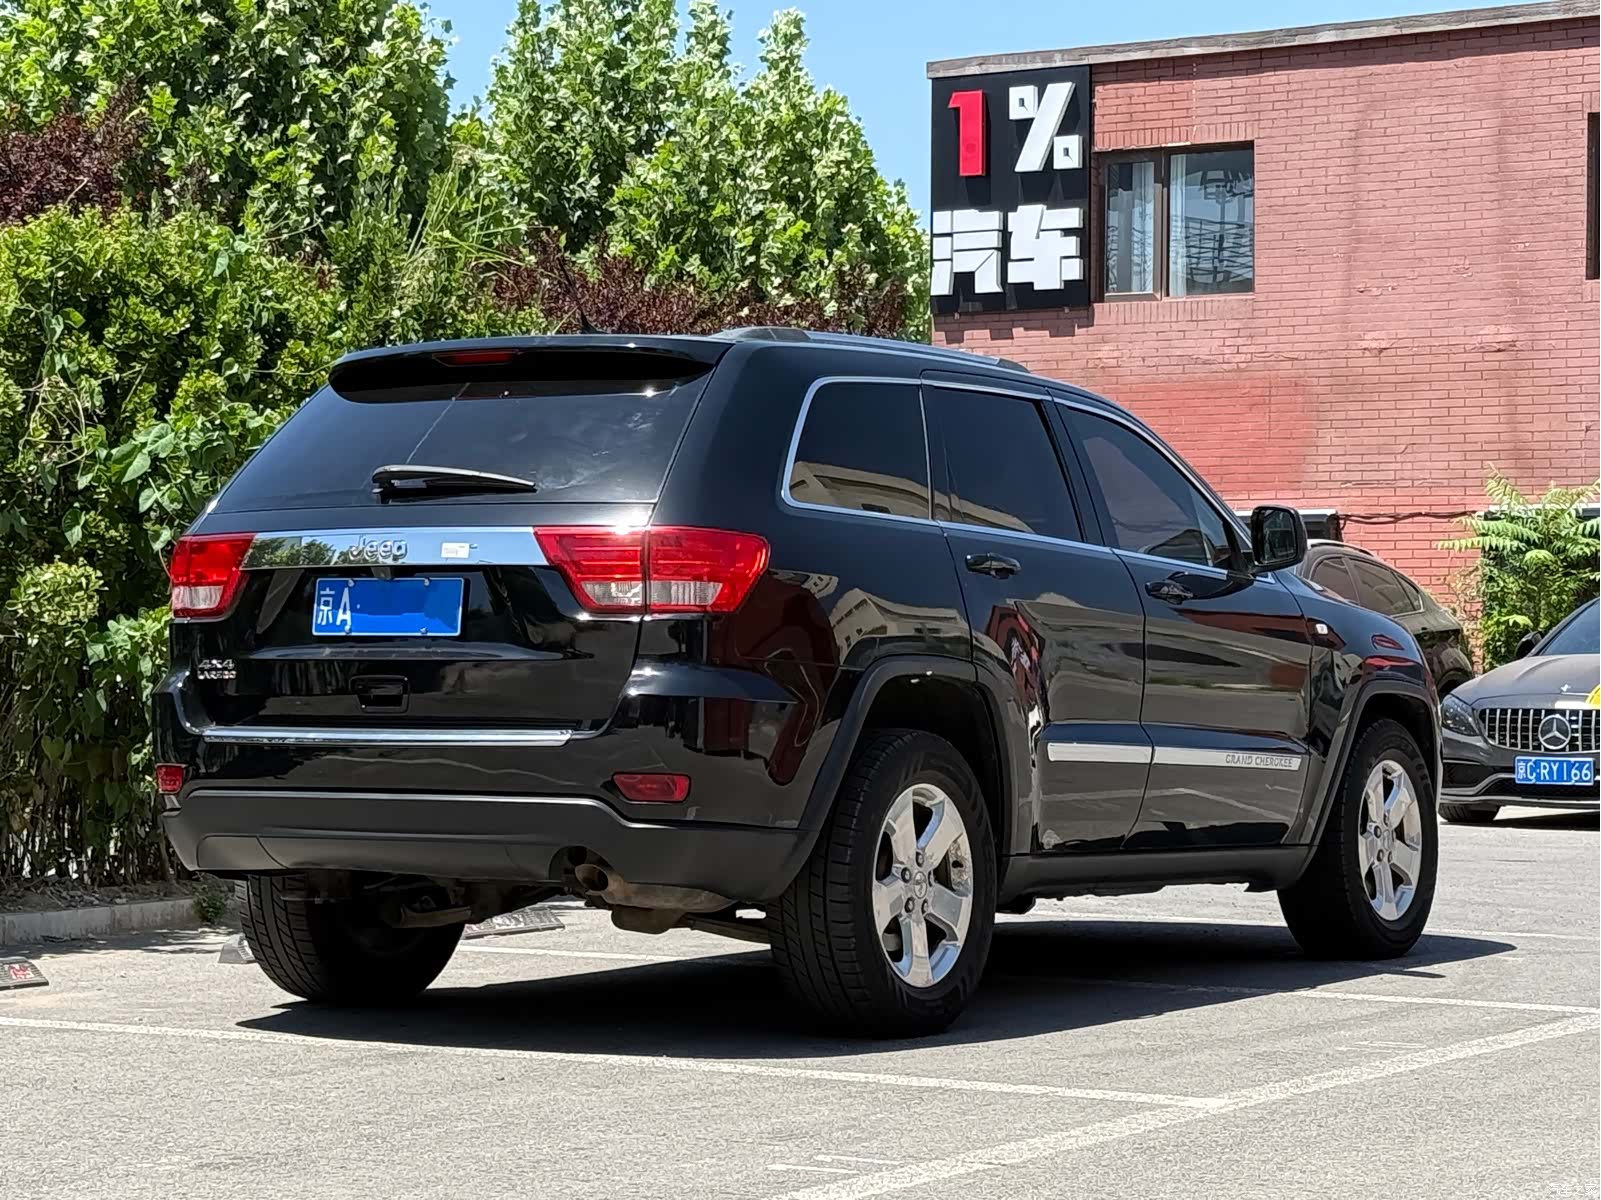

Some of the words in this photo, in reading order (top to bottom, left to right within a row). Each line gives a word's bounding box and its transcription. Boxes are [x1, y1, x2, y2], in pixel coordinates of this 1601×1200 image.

[930, 204, 1084, 296] 汽车
[349, 534, 408, 562] Jeep
[1225, 754, 1253, 766] GRAND
[1254, 756, 1293, 768] CHEROKEE
